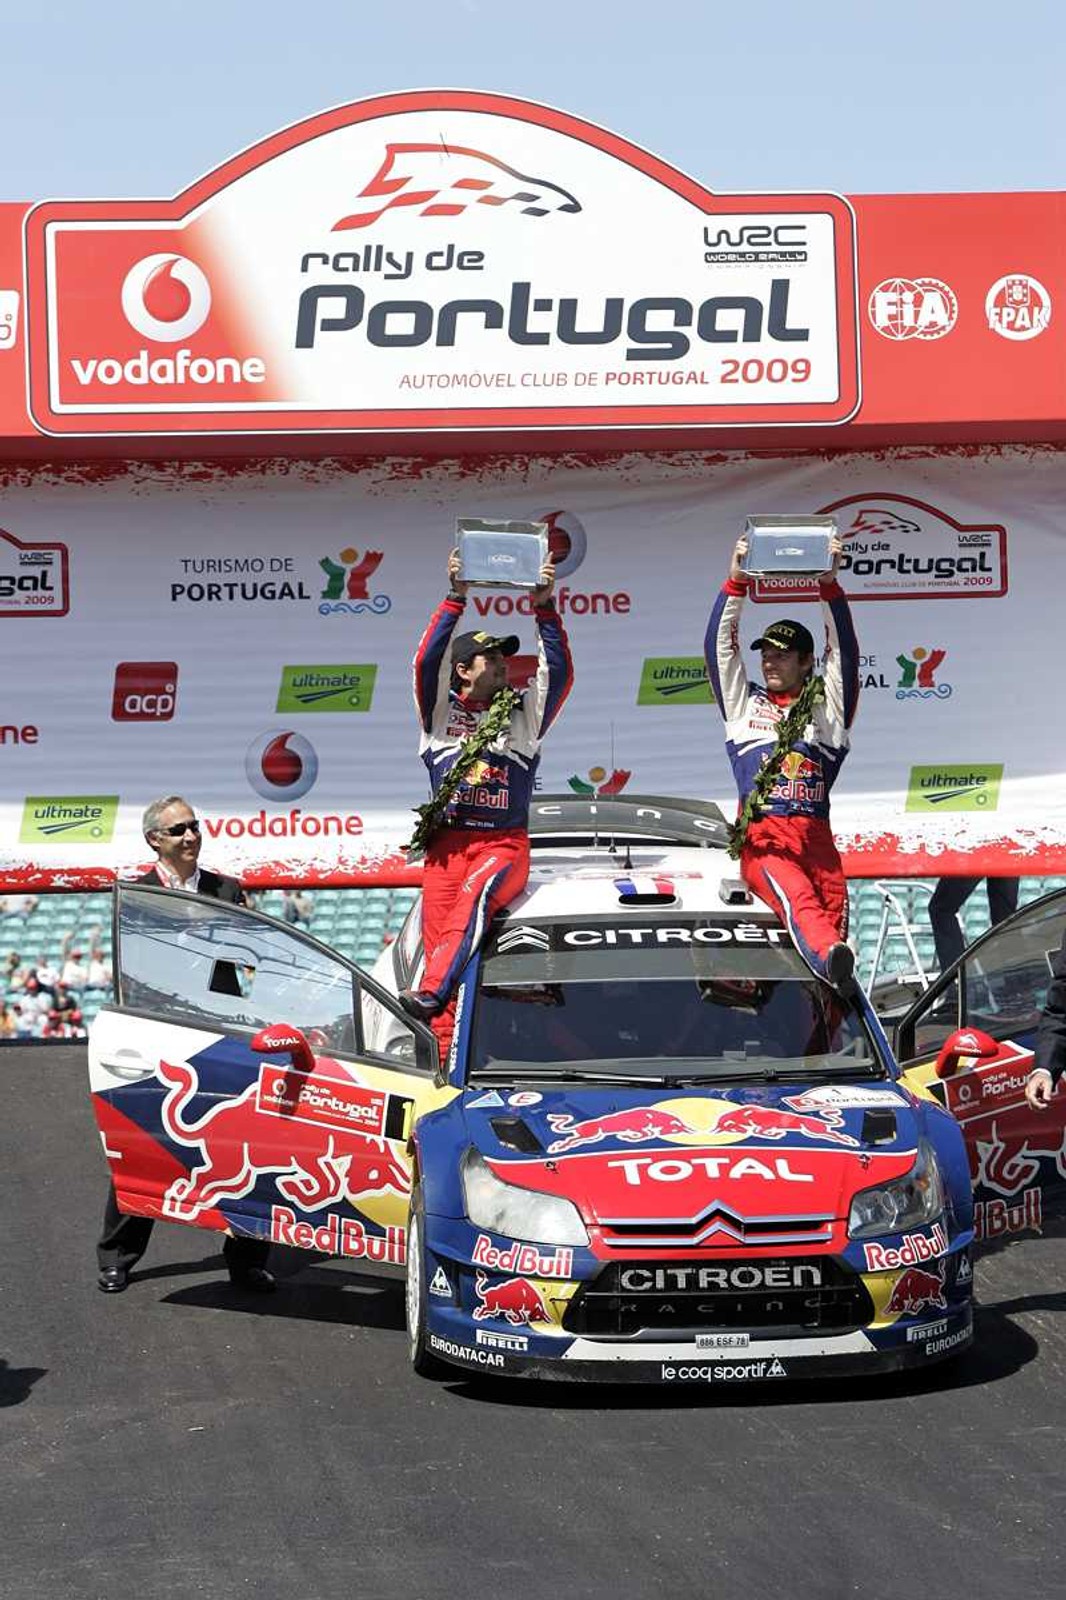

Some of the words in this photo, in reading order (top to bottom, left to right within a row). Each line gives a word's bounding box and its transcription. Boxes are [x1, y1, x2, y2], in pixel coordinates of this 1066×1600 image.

[703, 225, 807, 247] WRC
[301, 244, 413, 280] rally
[425, 244, 485, 271] de
[705, 252, 757, 262] WORLD
[758, 251, 806, 261] RALLY
[295, 278, 809, 361] Portugal
[70, 349, 266, 386] vodafone
[398, 369, 516, 390] AUTOMÓVEL
[521, 372, 568, 388] CLUB
[574, 371, 599, 388] DE
[604, 370, 710, 386] PORTUGAL
[720, 358, 812, 384] 2009
[842, 541, 868, 554] ally
[871, 543, 891, 551] de
[181, 558, 264, 573] TURISMO
[269, 558, 294, 573] DE
[171, 581, 311, 602] PORTUGAL
[963, 577, 993, 586] 2009
[24, 595, 54, 605] 2009
[472, 586, 632, 617] vodfone
[291, 672, 362, 689] ultimate
[652, 665, 709, 680] ultimat
[124, 693, 174, 716] acp
[770, 780, 794, 800] ed
[919, 772, 988, 790] ultimate
[33, 804, 103, 820] ultimate
[203, 809, 364, 839] vodafone
[263, 1035, 300, 1049] TOTAL
[982, 1075, 1028, 1097] Portu
[300, 1090, 380, 1120] Portugal
[608, 1157, 815, 1185] TOTAL
[476, 1329, 528, 1351] PIRELLI
[906, 1318, 948, 1343] PIRELLI
[430, 1334, 505, 1367] EURODATACAR
[661, 1363, 676, 1380] le
[678, 1366, 711, 1382] coq
[714, 1362, 767, 1380] sportif
